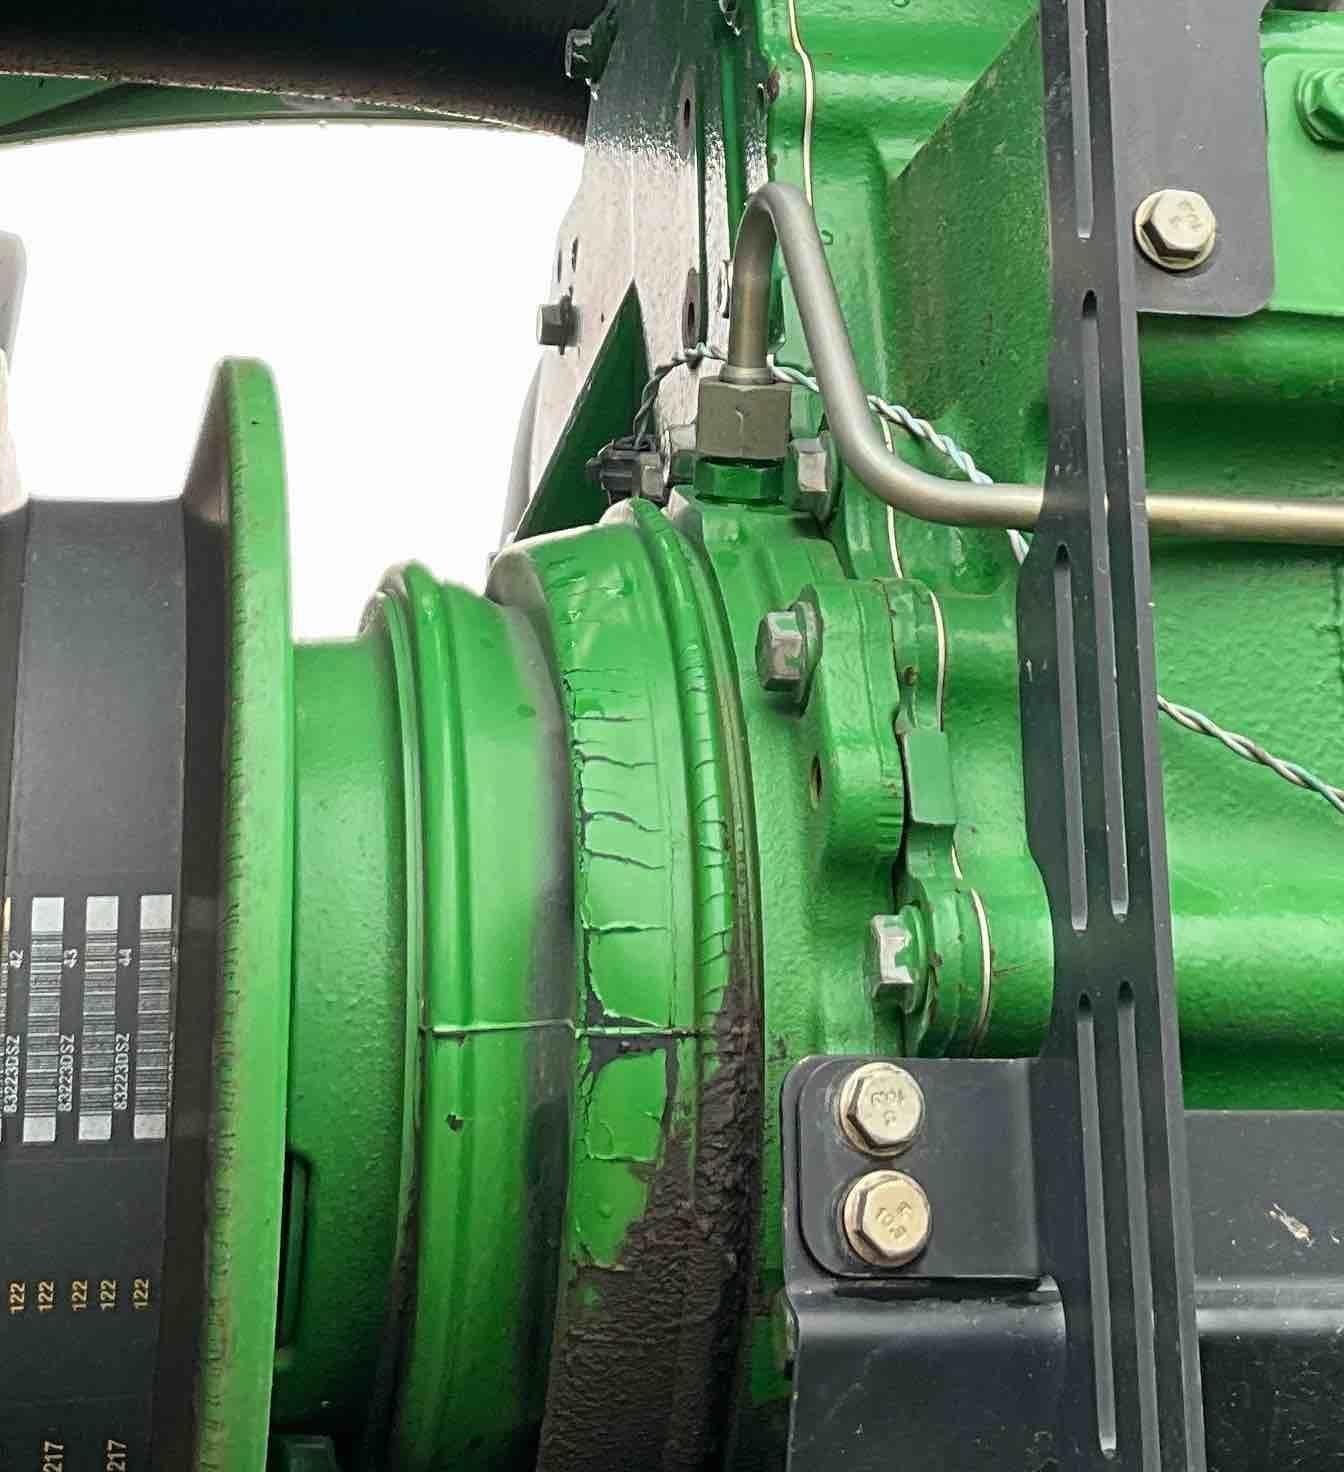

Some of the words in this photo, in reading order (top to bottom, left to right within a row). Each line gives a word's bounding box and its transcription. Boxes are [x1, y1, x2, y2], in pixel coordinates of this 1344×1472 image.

[9, 1282, 26, 1315] 122
[37, 1281, 55, 1313] 122
[72, 1280, 89, 1312] 122
[99, 1279, 117, 1311] 122
[132, 1279, 149, 1310] 122
